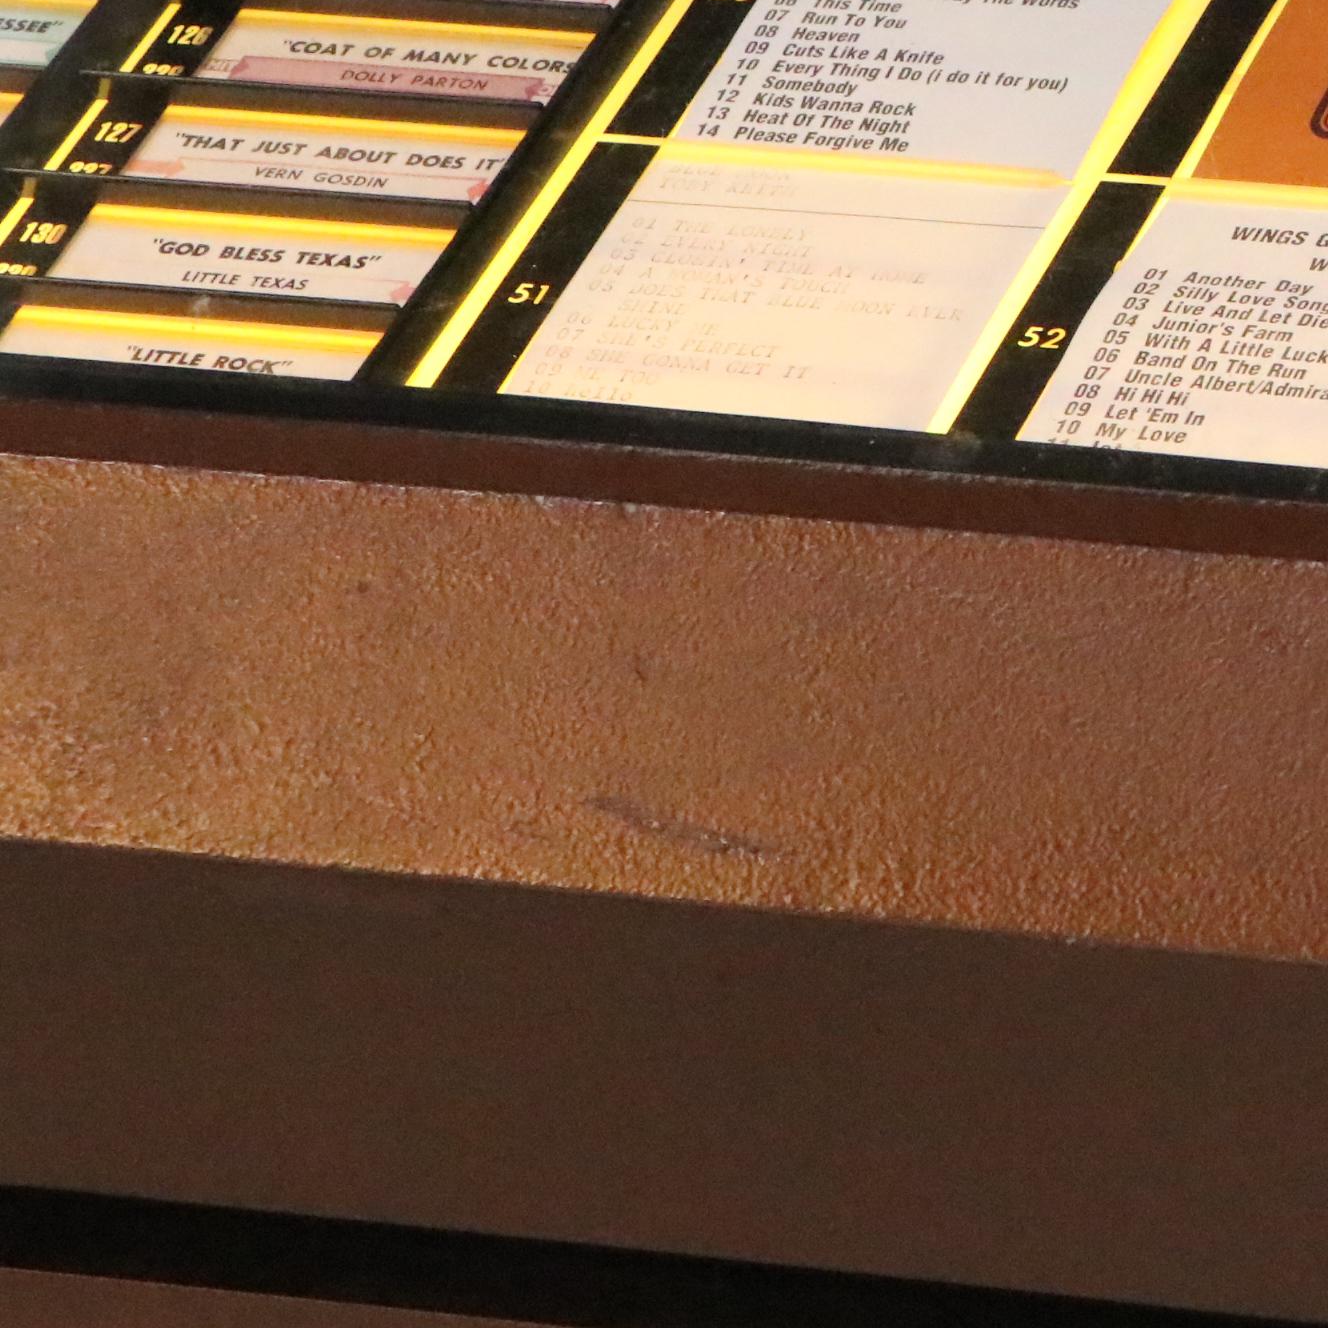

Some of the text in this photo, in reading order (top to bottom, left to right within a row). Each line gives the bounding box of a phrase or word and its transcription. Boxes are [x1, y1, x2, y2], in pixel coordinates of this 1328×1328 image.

[754, 25, 861, 43] 08 Heaven
[94, 120, 143, 143] 127
[176, 132, 246, 153] "THAT
[253, 138, 307, 156] JUST
[315, 143, 396, 163] ABOUT
[406, 151, 464, 169] DOES
[254, 165, 390, 189] VERN GOSDIN
[19, 222, 65, 243] 130
[1231, 226, 1310, 247] WINGS
[154, 238, 383, 270] "GOD BLESS TEXAS"
[182, 270, 309, 291] LITTLE TEXAS
[1144, 267, 1315, 297] 01 Another Day
[508, 284, 550, 305] 51
[1018, 327, 1066, 349] 52
[128, 345, 293, 374] "LITTLE ROCK"
